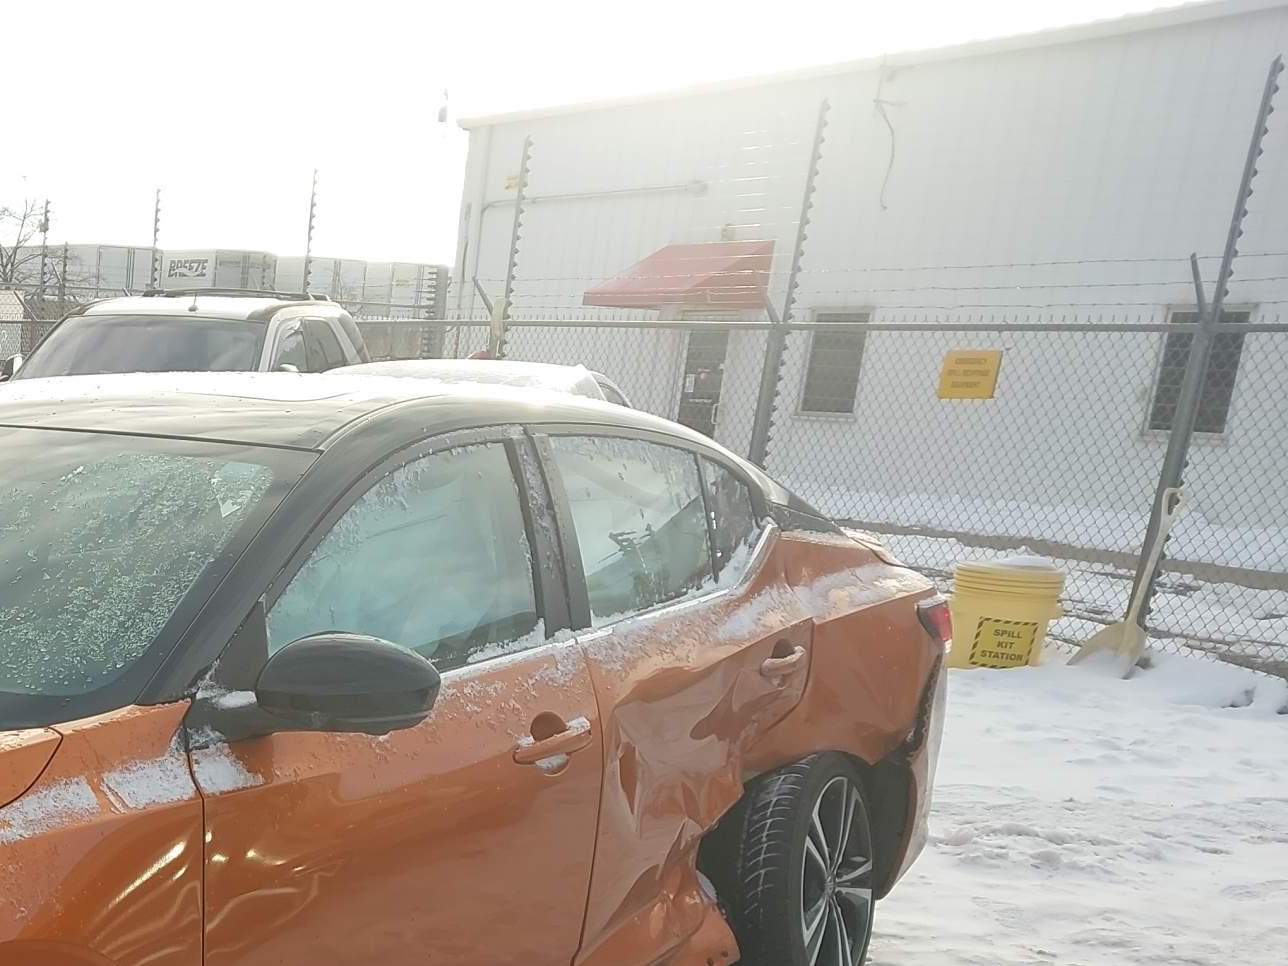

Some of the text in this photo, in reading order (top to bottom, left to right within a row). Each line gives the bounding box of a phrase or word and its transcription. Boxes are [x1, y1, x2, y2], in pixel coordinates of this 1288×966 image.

[993, 629, 1023, 639] SPILL
[997, 641, 1015, 649] KIT
[980, 649, 1023, 661] STATION
